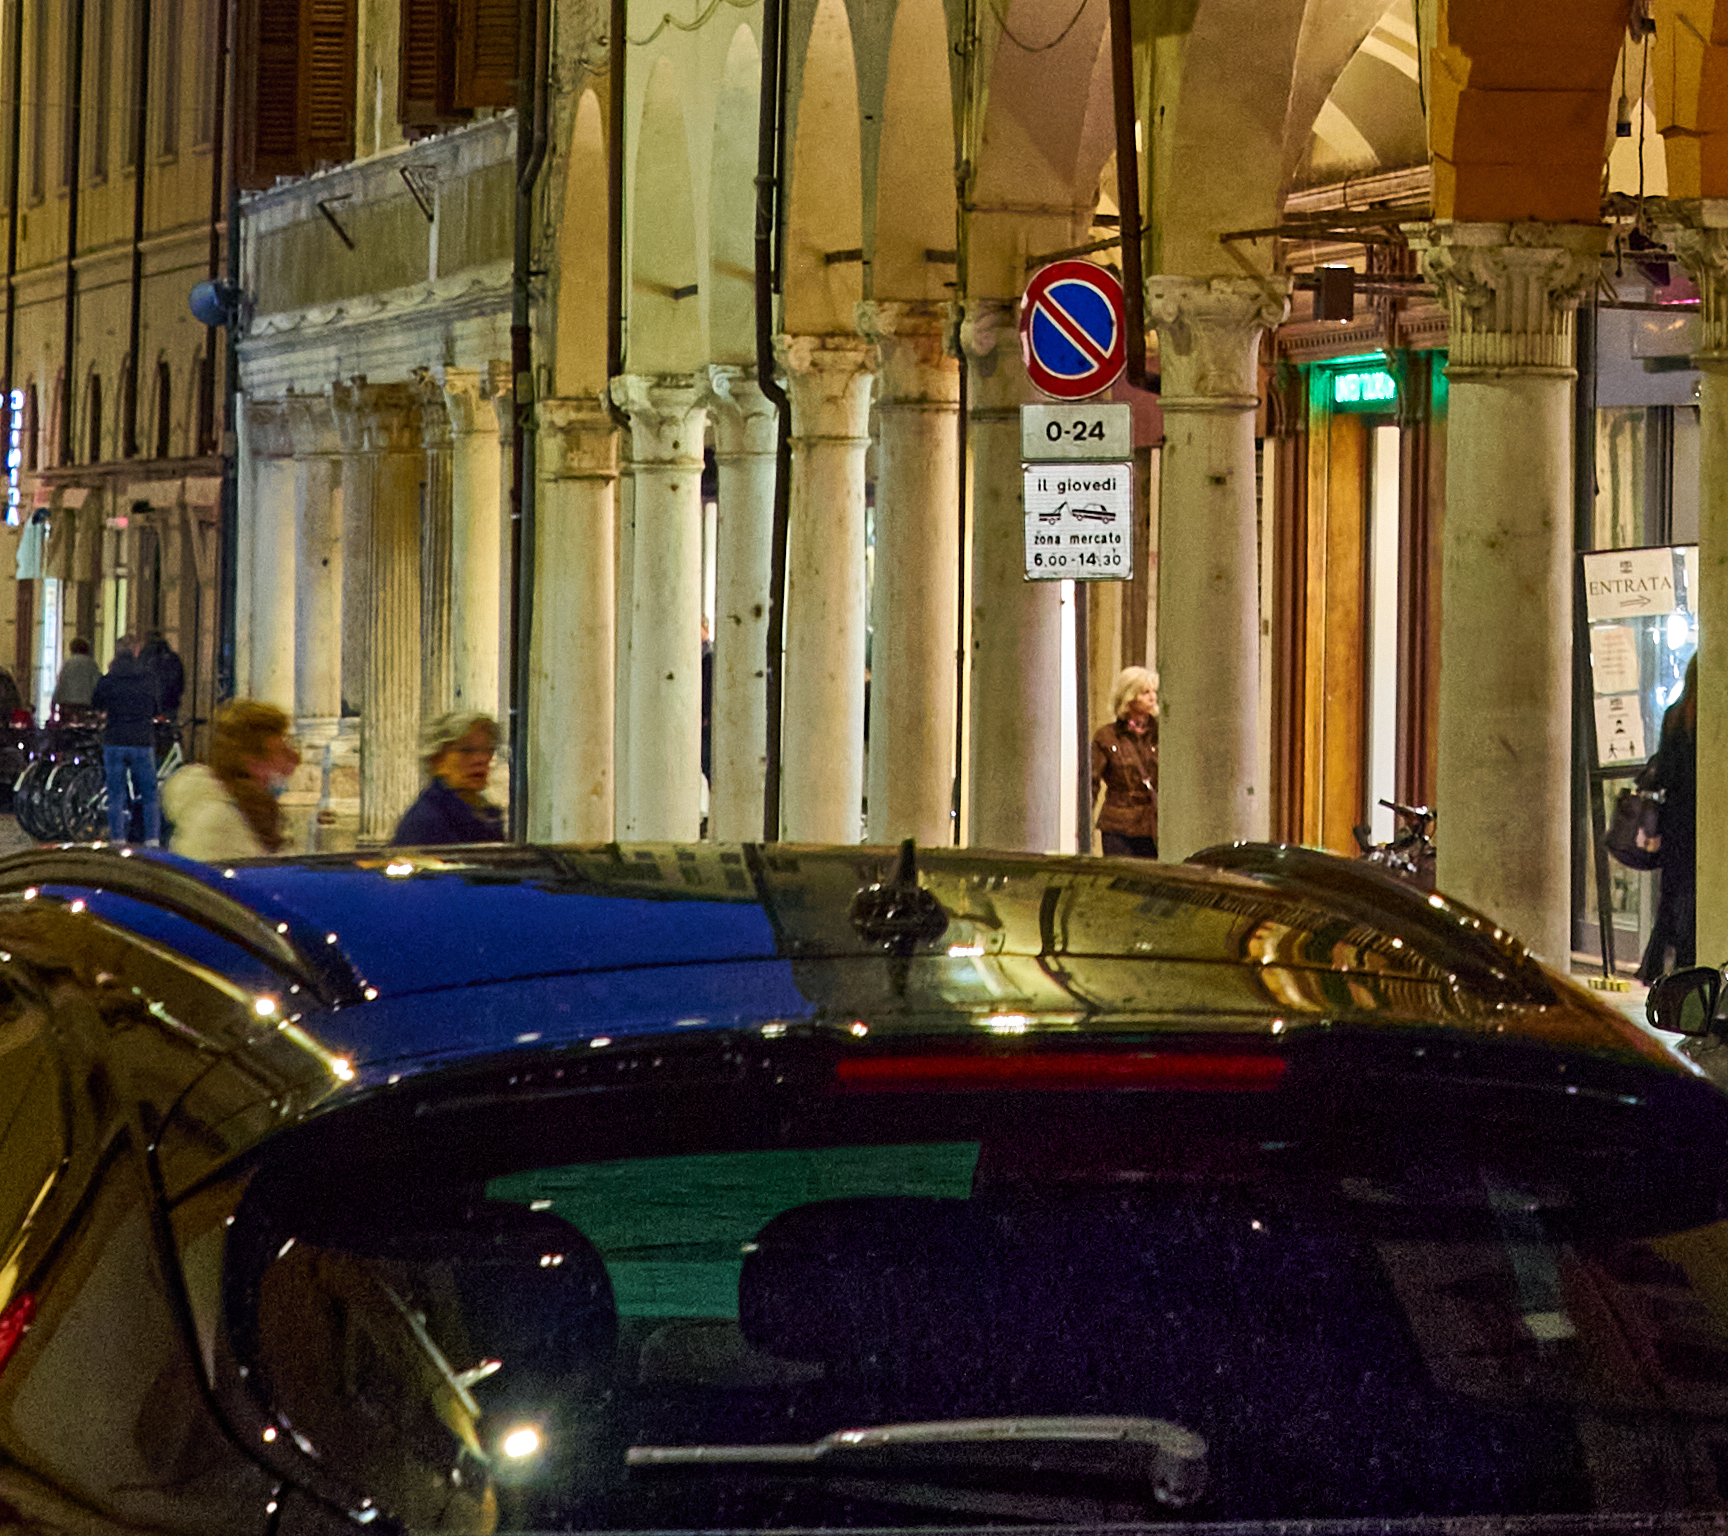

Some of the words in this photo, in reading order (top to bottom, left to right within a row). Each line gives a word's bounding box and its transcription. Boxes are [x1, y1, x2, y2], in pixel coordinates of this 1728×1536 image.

[1046, 421, 1105, 441] 0-24
[1038, 478, 1048, 491] il
[1034, 534, 1061, 545] zona
[1070, 531, 1121, 545] mercato
[1589, 576, 1673, 596] ENTRATA
